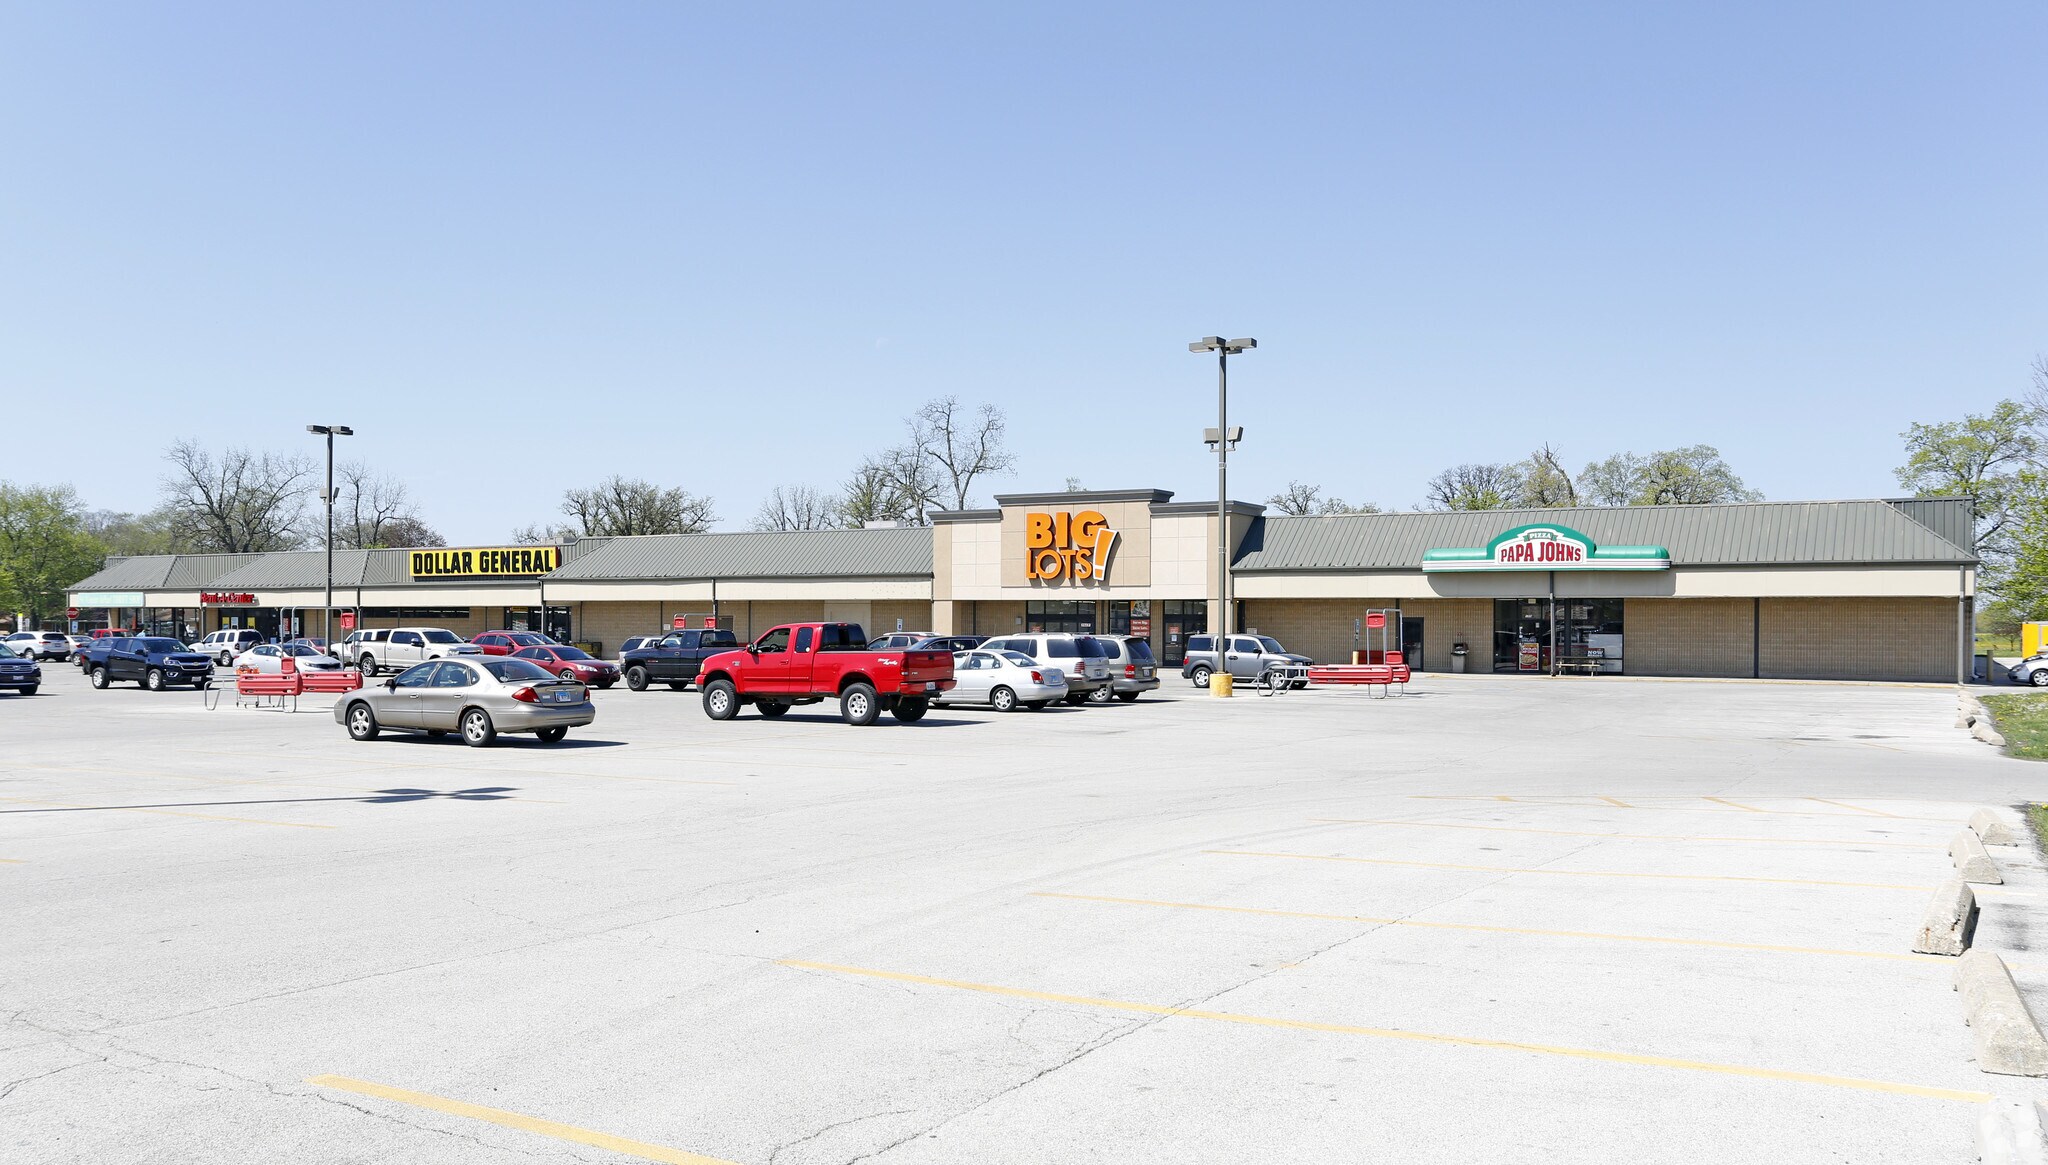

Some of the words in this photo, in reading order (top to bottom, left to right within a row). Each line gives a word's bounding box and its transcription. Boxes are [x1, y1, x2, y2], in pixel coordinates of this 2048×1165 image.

[1026, 510, 1107, 548] BIG
[1529, 532, 1552, 540] PIZZA
[413, 551, 473, 574] DOLLAR
[479, 549, 553, 573] GENERAL
[1500, 542, 1535, 563] PAPA
[1537, 541, 1582, 563] JOHNS
[201, 592, 255, 604] Rent-A-Center
